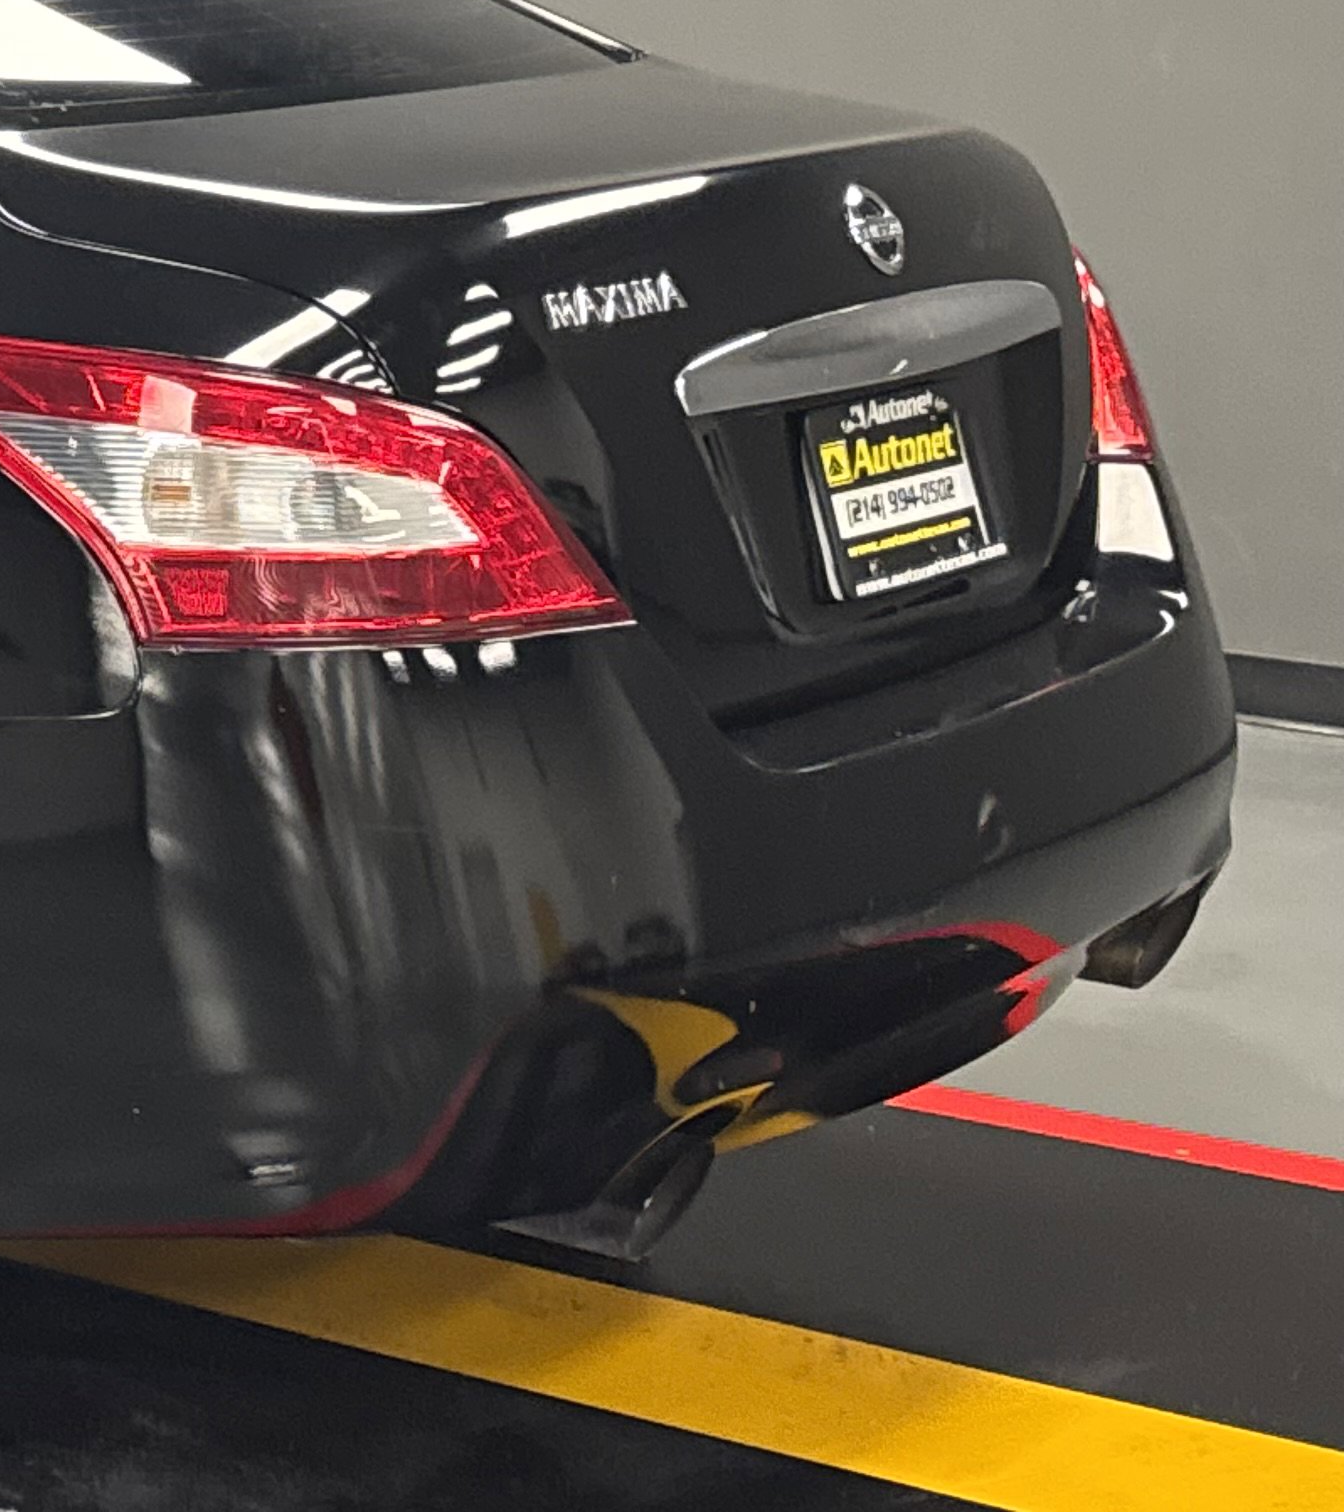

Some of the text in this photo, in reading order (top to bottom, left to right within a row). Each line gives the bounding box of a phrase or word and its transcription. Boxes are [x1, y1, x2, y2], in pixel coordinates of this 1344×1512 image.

[542, 270, 688, 330] MAXIMA
[853, 422, 957, 479] Autonet
[846, 494, 886, 528] (214)
